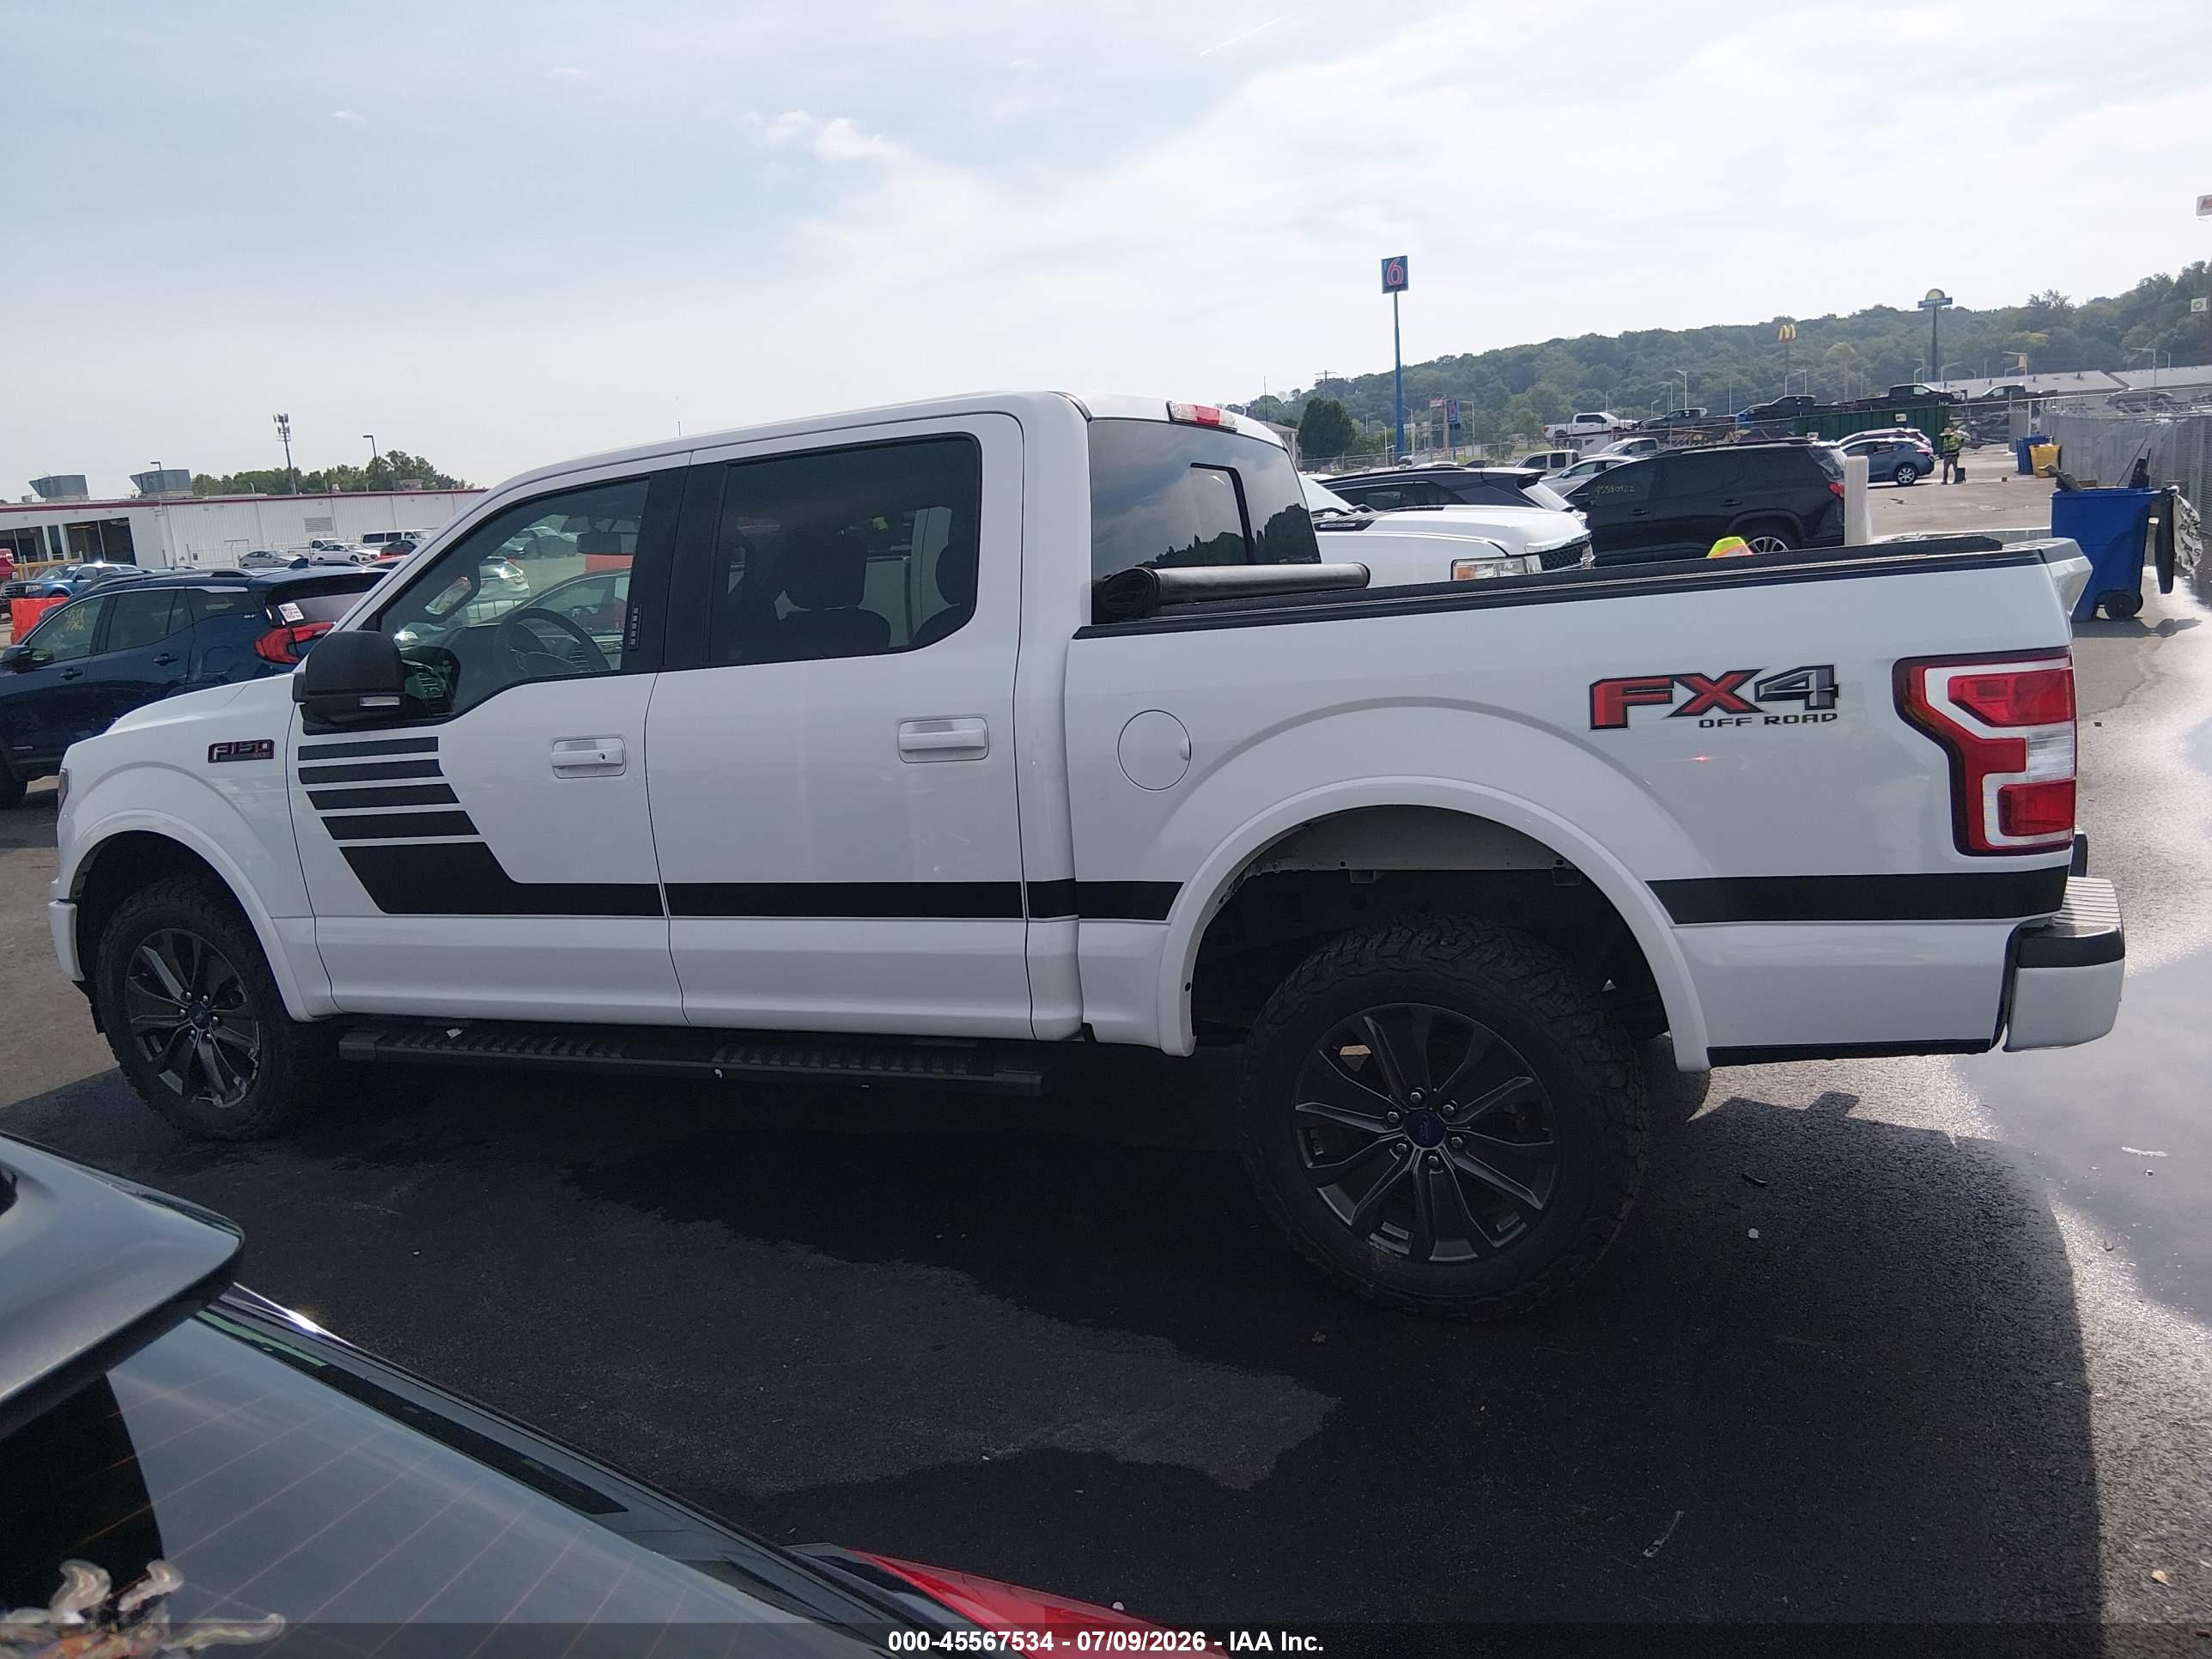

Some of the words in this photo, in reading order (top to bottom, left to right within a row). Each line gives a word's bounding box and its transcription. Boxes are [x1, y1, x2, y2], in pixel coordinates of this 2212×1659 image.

[1387, 258, 1404, 286] 6
[1589, 665, 1839, 730] FX4
[1698, 716, 1753, 728] OFF
[1764, 713, 1838, 726] ROAD
